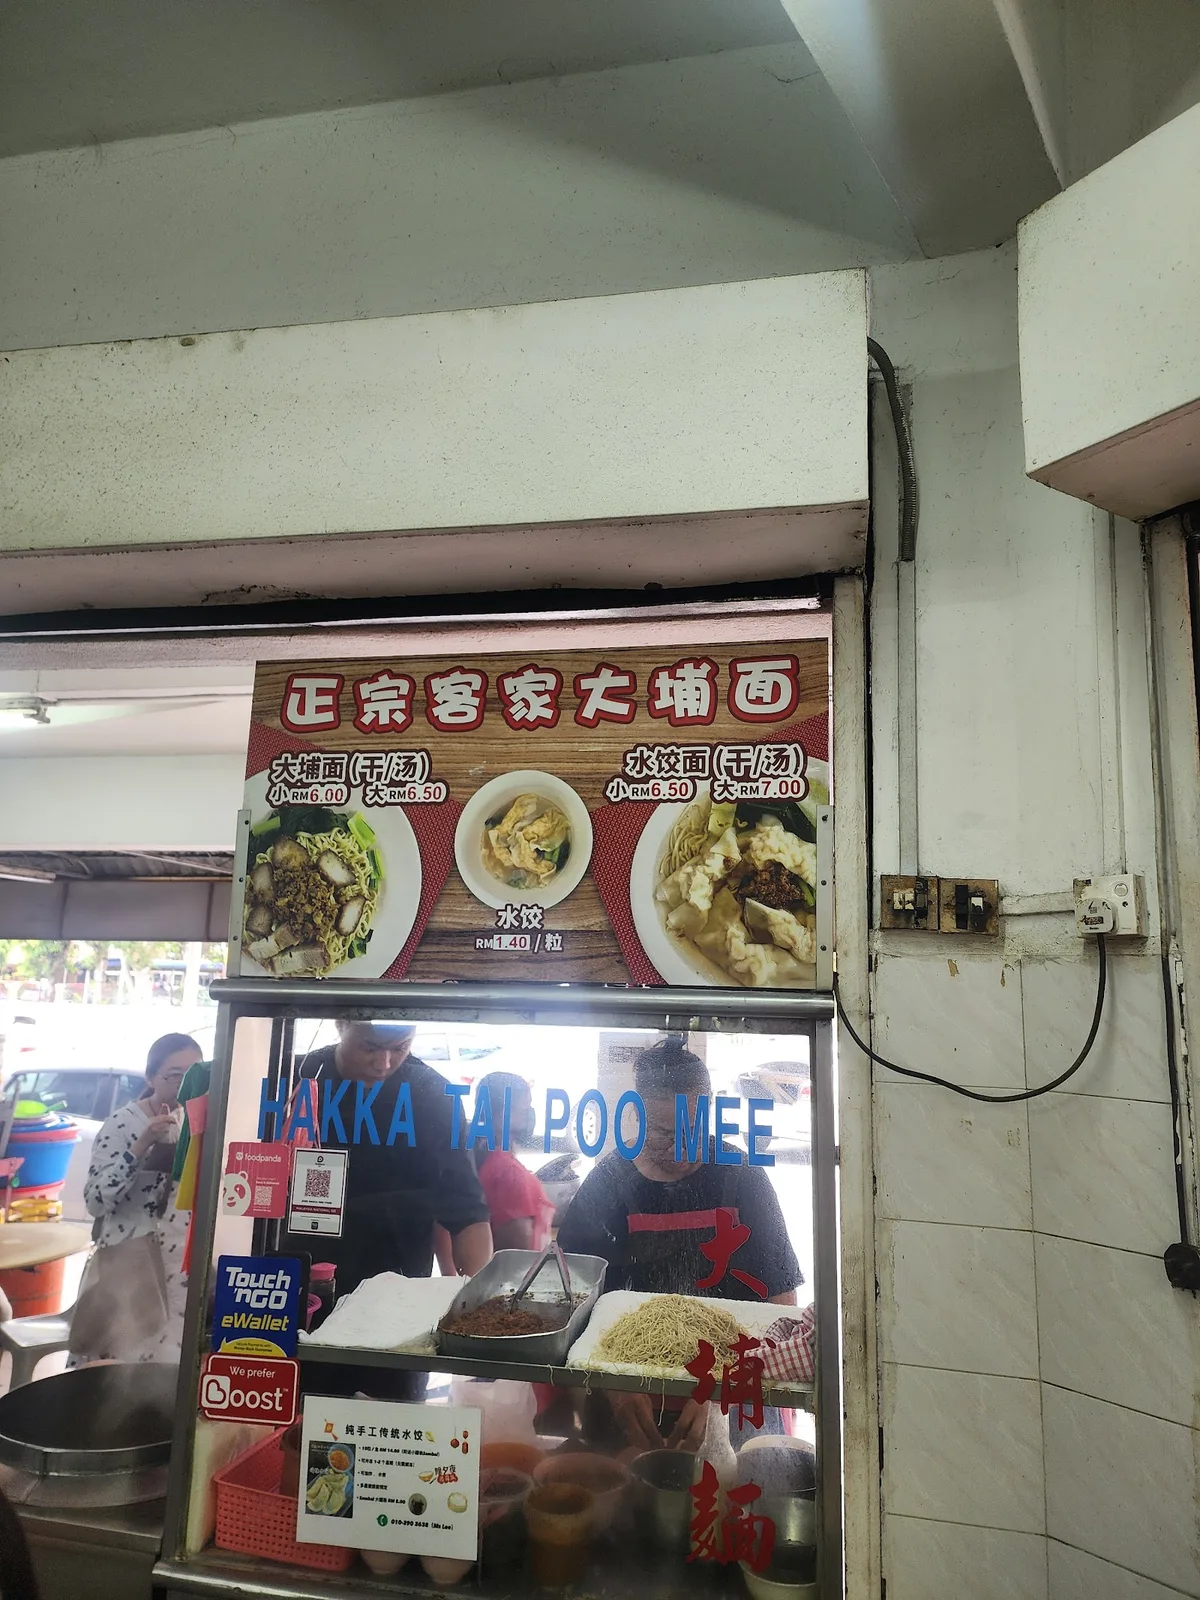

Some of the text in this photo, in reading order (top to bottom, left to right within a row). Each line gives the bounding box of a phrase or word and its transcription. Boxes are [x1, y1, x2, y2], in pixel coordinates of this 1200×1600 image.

[284, 657, 797, 730] 正宗客家大埔面
[496, 904, 545, 931] 水饺
[257, 1077, 777, 1168] HAKKA TAI POO MEE
[245, 1153, 282, 1163] foodpanda
[225, 1266, 292, 1290] Touch
[221, 1312, 290, 1331] eWallet
[229, 1365, 276, 1379] We prefer
[345, 1423, 423, 1441] 纯手工传统水饺
